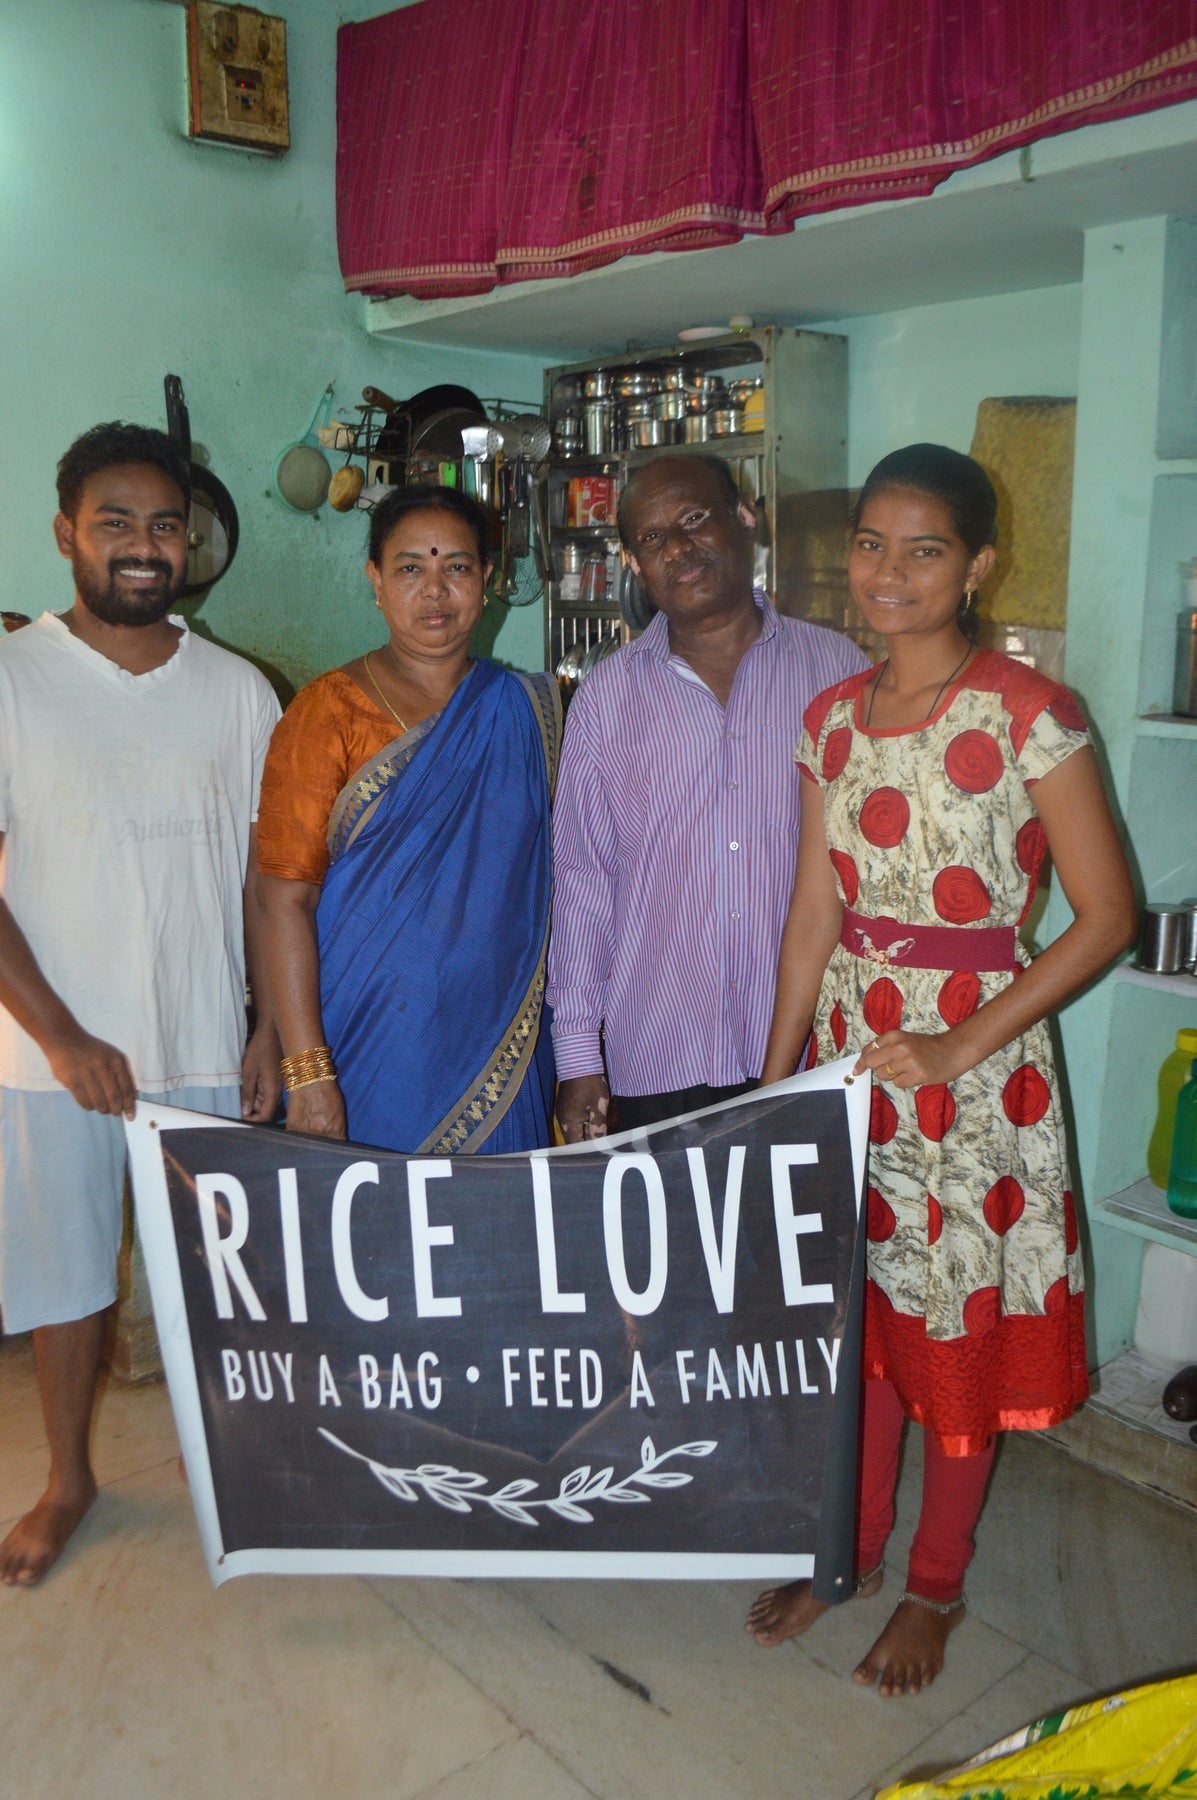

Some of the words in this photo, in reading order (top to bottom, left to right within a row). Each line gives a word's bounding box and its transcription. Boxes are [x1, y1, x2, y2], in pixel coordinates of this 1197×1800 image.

[195, 1159, 463, 1322] RICE
[531, 1143, 834, 1316] LOVE
[221, 1349, 295, 1403] BUY
[319, 1355, 342, 1406] A
[358, 1350, 442, 1409] BAG
[503, 1348, 602, 1407] FEED
[629, 1350, 654, 1407] A
[676, 1338, 841, 1403] FAMILY
